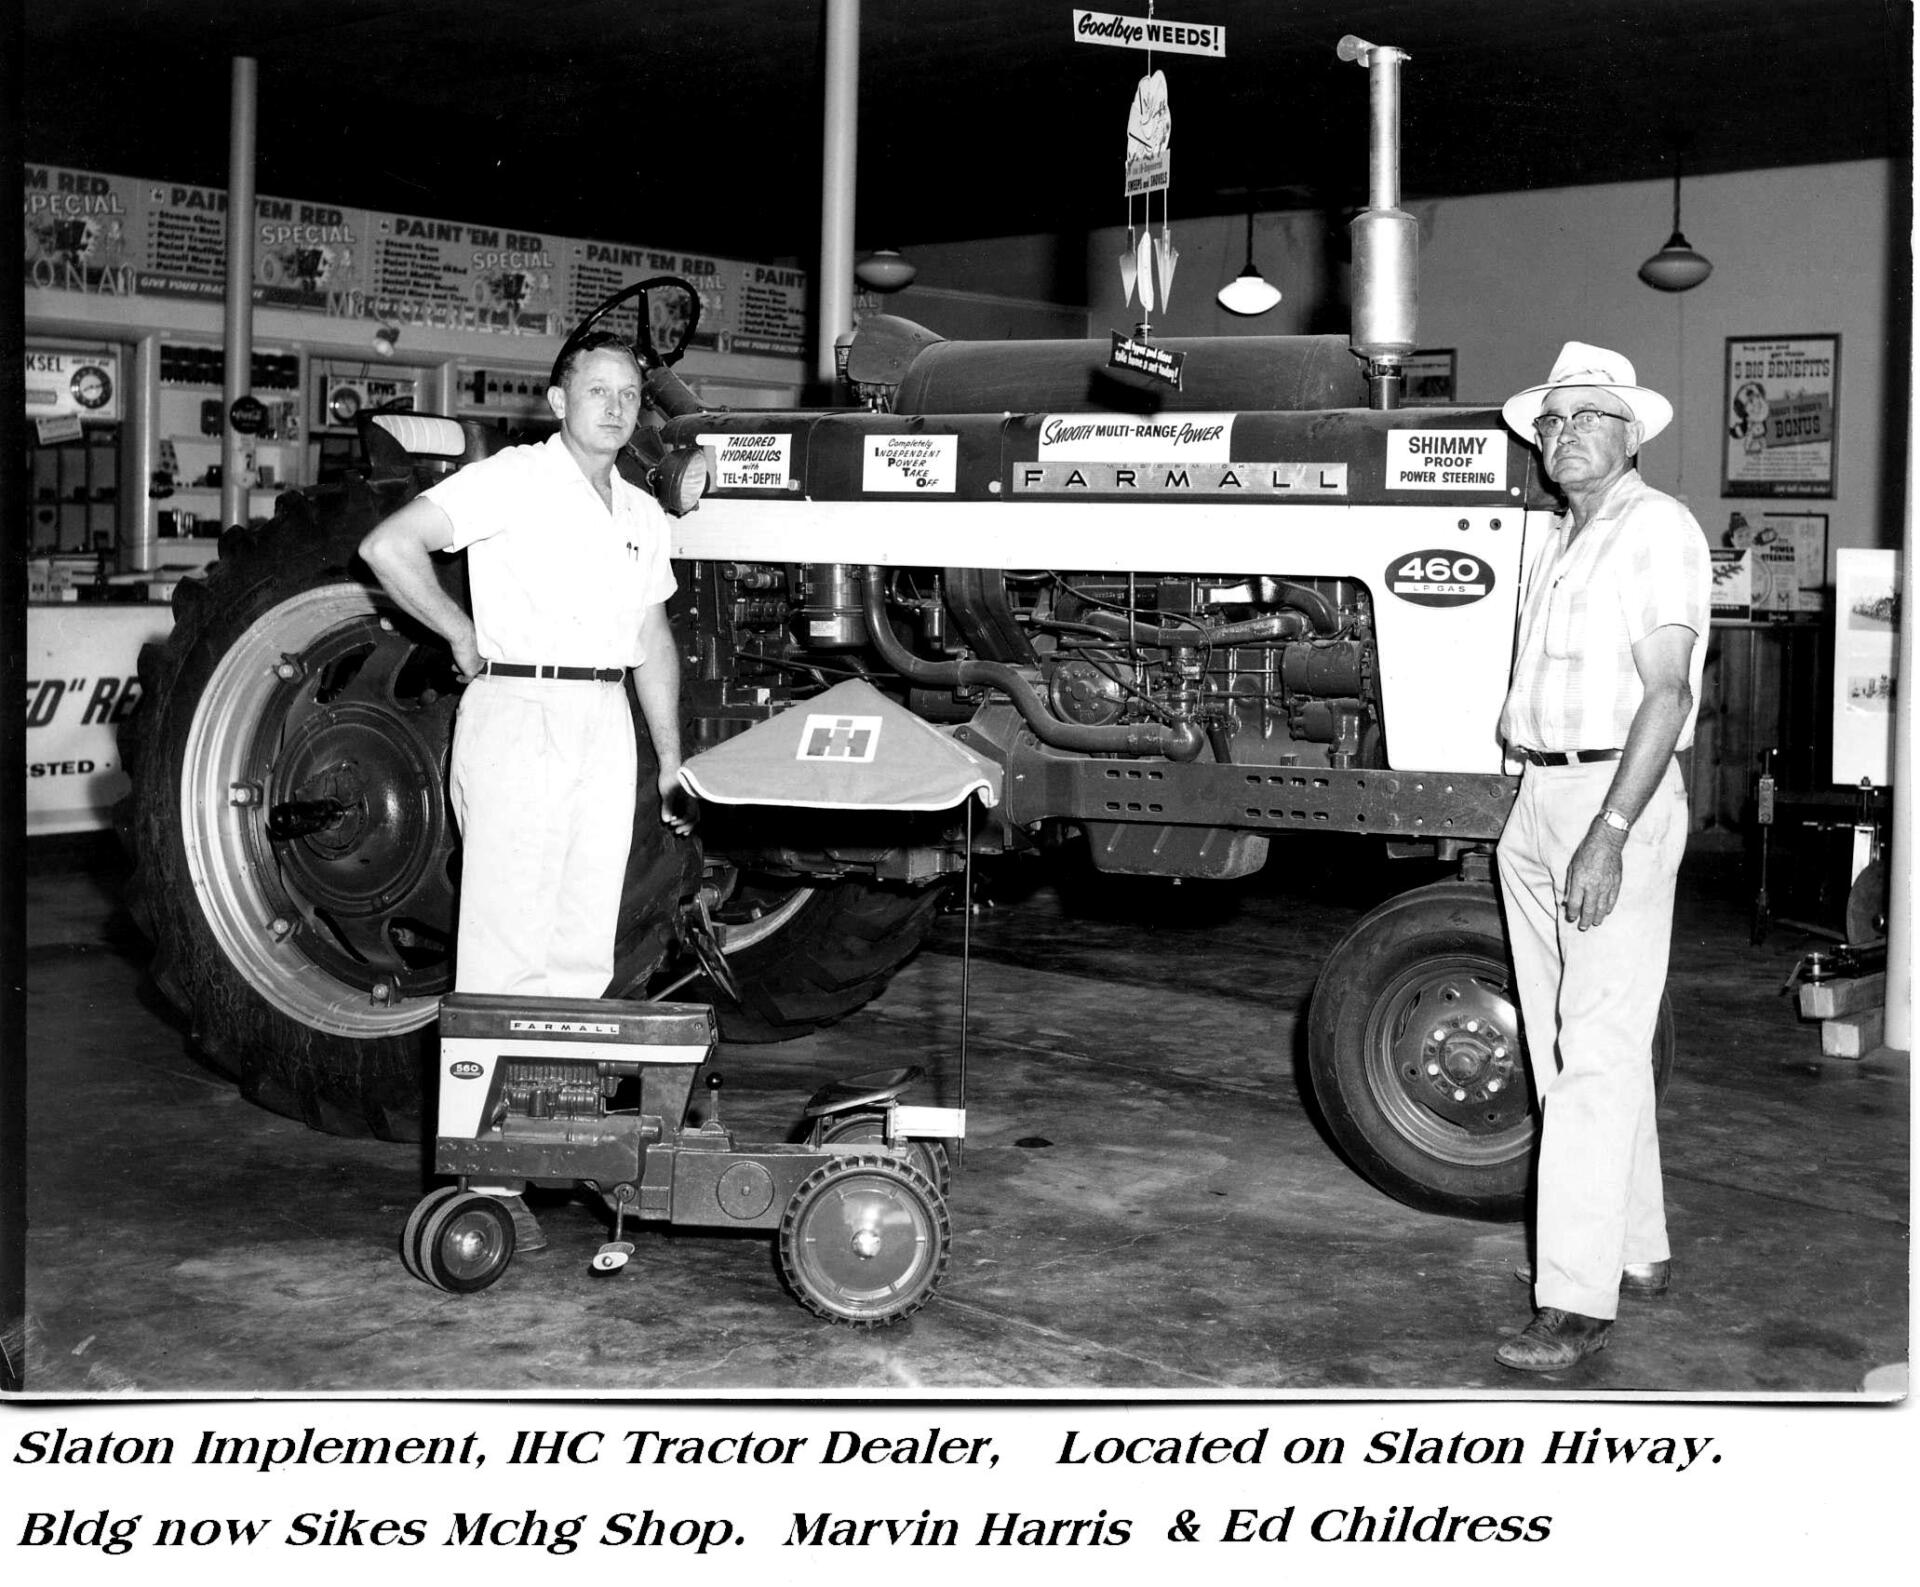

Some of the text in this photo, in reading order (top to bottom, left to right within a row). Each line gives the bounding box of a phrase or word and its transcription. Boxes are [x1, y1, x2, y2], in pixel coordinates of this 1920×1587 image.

[1078, 13, 1219, 51] Goodbye WEEDS!
[58, 171, 109, 196] RED
[25, 192, 126, 215] PECIAL
[300, 205, 343, 227] RED
[261, 225, 356, 245] SPECIAL
[395, 218, 463, 243] PAINT
[506, 233, 543, 253] RED
[472, 250, 554, 271] SPECIAL
[586, 244, 643, 267] PAINT
[682, 257, 716, 276] RED
[755, 267, 806, 288] PAINT
[26, 355, 64, 372] KSEL
[1768, 358, 1830, 378] BENEFITS
[1042, 419, 1224, 446] SMOOTH MULTI-RANGE POWER
[1775, 415, 1821, 439] BONUS
[727, 436, 777, 447] TAILORED
[888, 438, 933, 450] Completely
[1408, 436, 1487, 455] SHIMMY
[720, 450, 782, 462] HYDRAULICS
[874, 447, 941, 458] INDEPENDENT
[742, 463, 760, 471] with
[887, 457, 927, 468] POWER
[1424, 456, 1473, 468] PROOF
[723, 472, 782, 485] TEL-A-DEPTH
[902, 467, 929, 478] TAKE
[1024, 469, 1339, 489] FARMALL
[1400, 470, 1495, 484] POWER STEERING
[916, 477, 939, 488] OFF
[1398, 557, 1480, 582] 460
[1437, 584, 1467, 593] GAS
[27, 760, 95, 778] STED
[513, 1022, 617, 1034] FARMALL
[456, 1063, 479, 1073] 560
